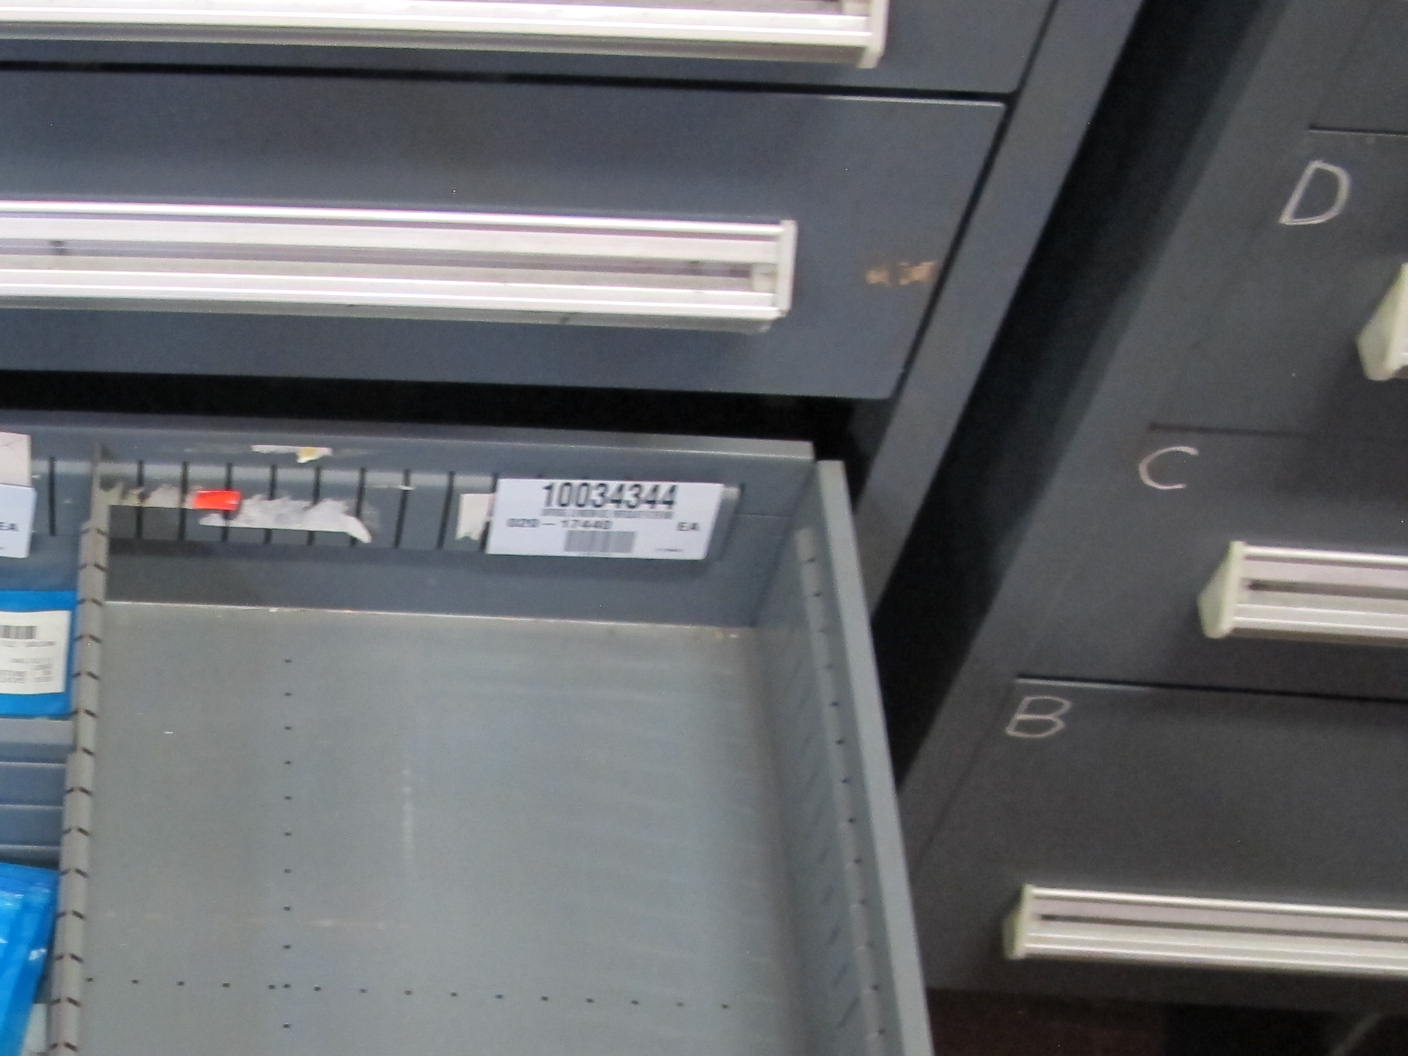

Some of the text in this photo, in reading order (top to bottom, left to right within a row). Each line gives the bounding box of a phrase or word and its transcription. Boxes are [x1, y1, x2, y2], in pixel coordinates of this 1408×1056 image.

[1279, 159, 1351, 225] D
[1138, 445, 1199, 490] C
[542, 481, 678, 511] 10034344
[1005, 695, 1072, 739] B
